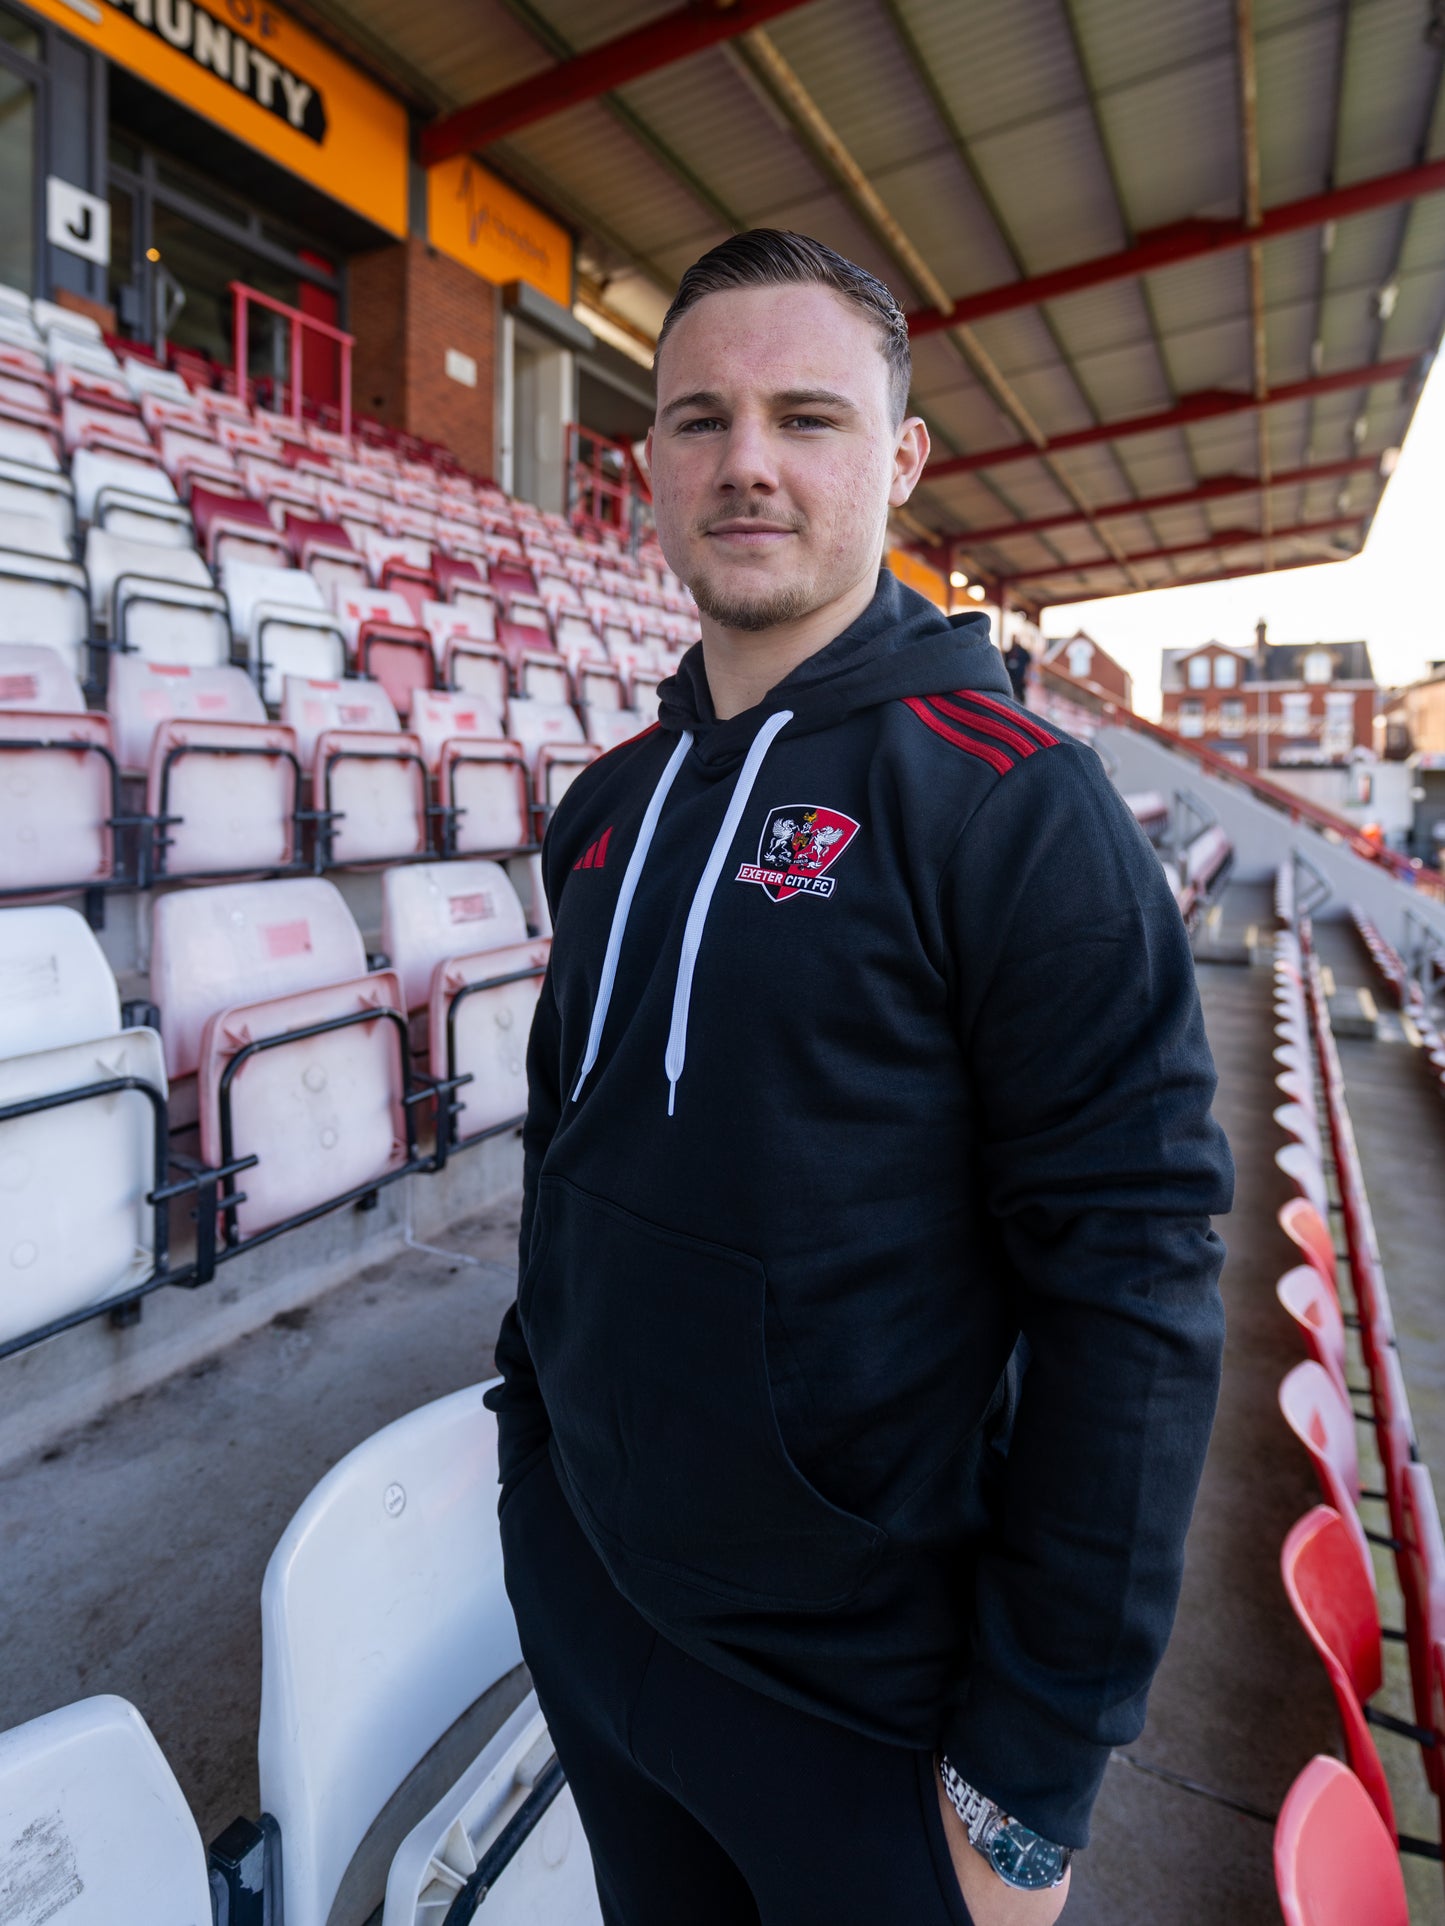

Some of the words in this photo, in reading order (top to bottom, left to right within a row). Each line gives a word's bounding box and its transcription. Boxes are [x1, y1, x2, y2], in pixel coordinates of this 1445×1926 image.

[66, 206, 92, 242] J
[740, 868, 784, 884] EXETER
[785, 875, 812, 889] CITY
[812, 879, 829, 892] FC
